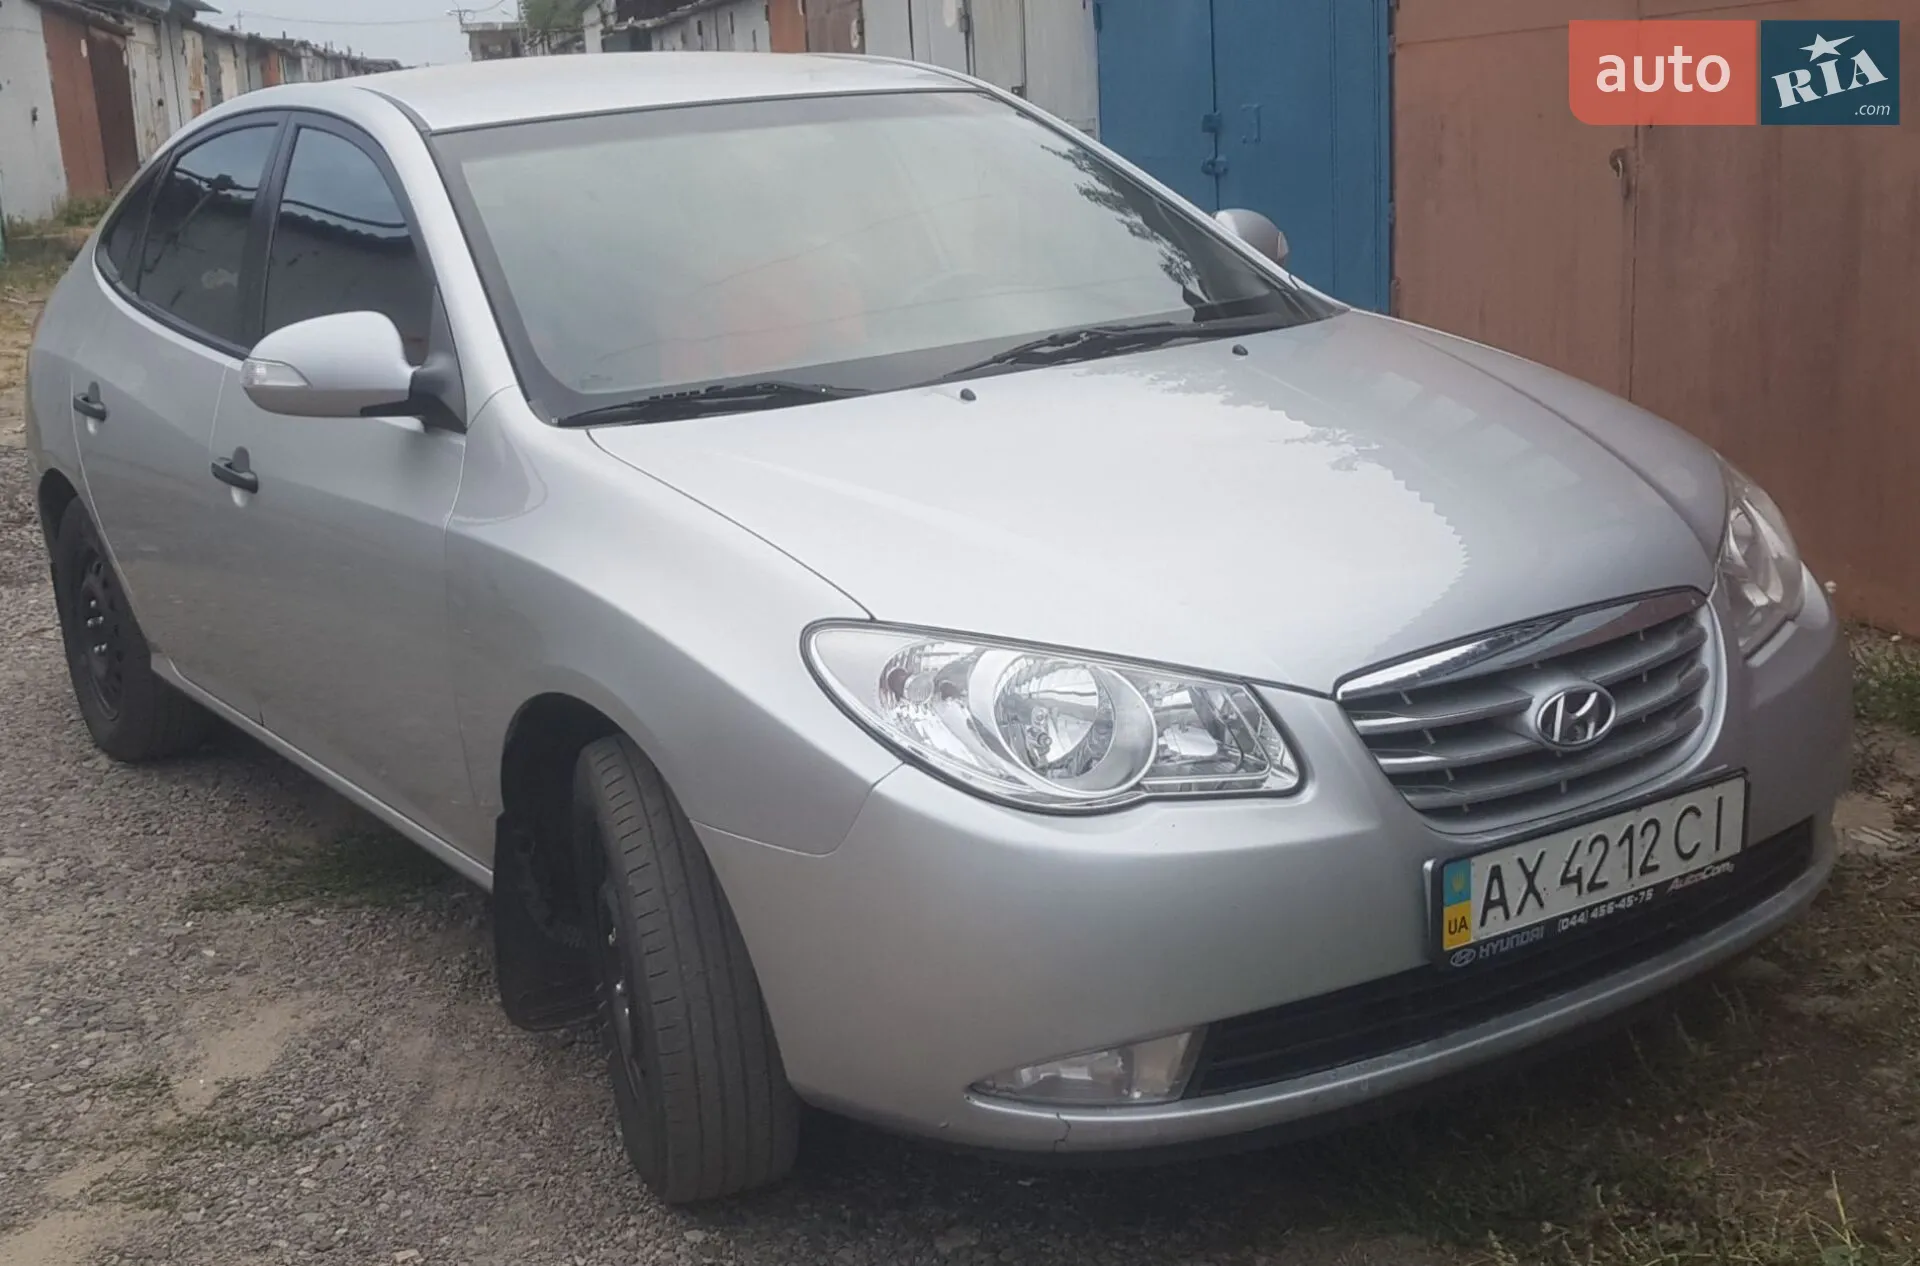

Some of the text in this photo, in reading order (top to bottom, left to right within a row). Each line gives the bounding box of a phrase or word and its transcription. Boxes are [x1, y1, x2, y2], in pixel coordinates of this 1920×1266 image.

[1479, 795, 1724, 928] AX 4212 CI
[1447, 913, 1469, 936] UA
[1479, 925, 1545, 960] HYUNDAI
[1557, 910, 1588, 933] (044)
